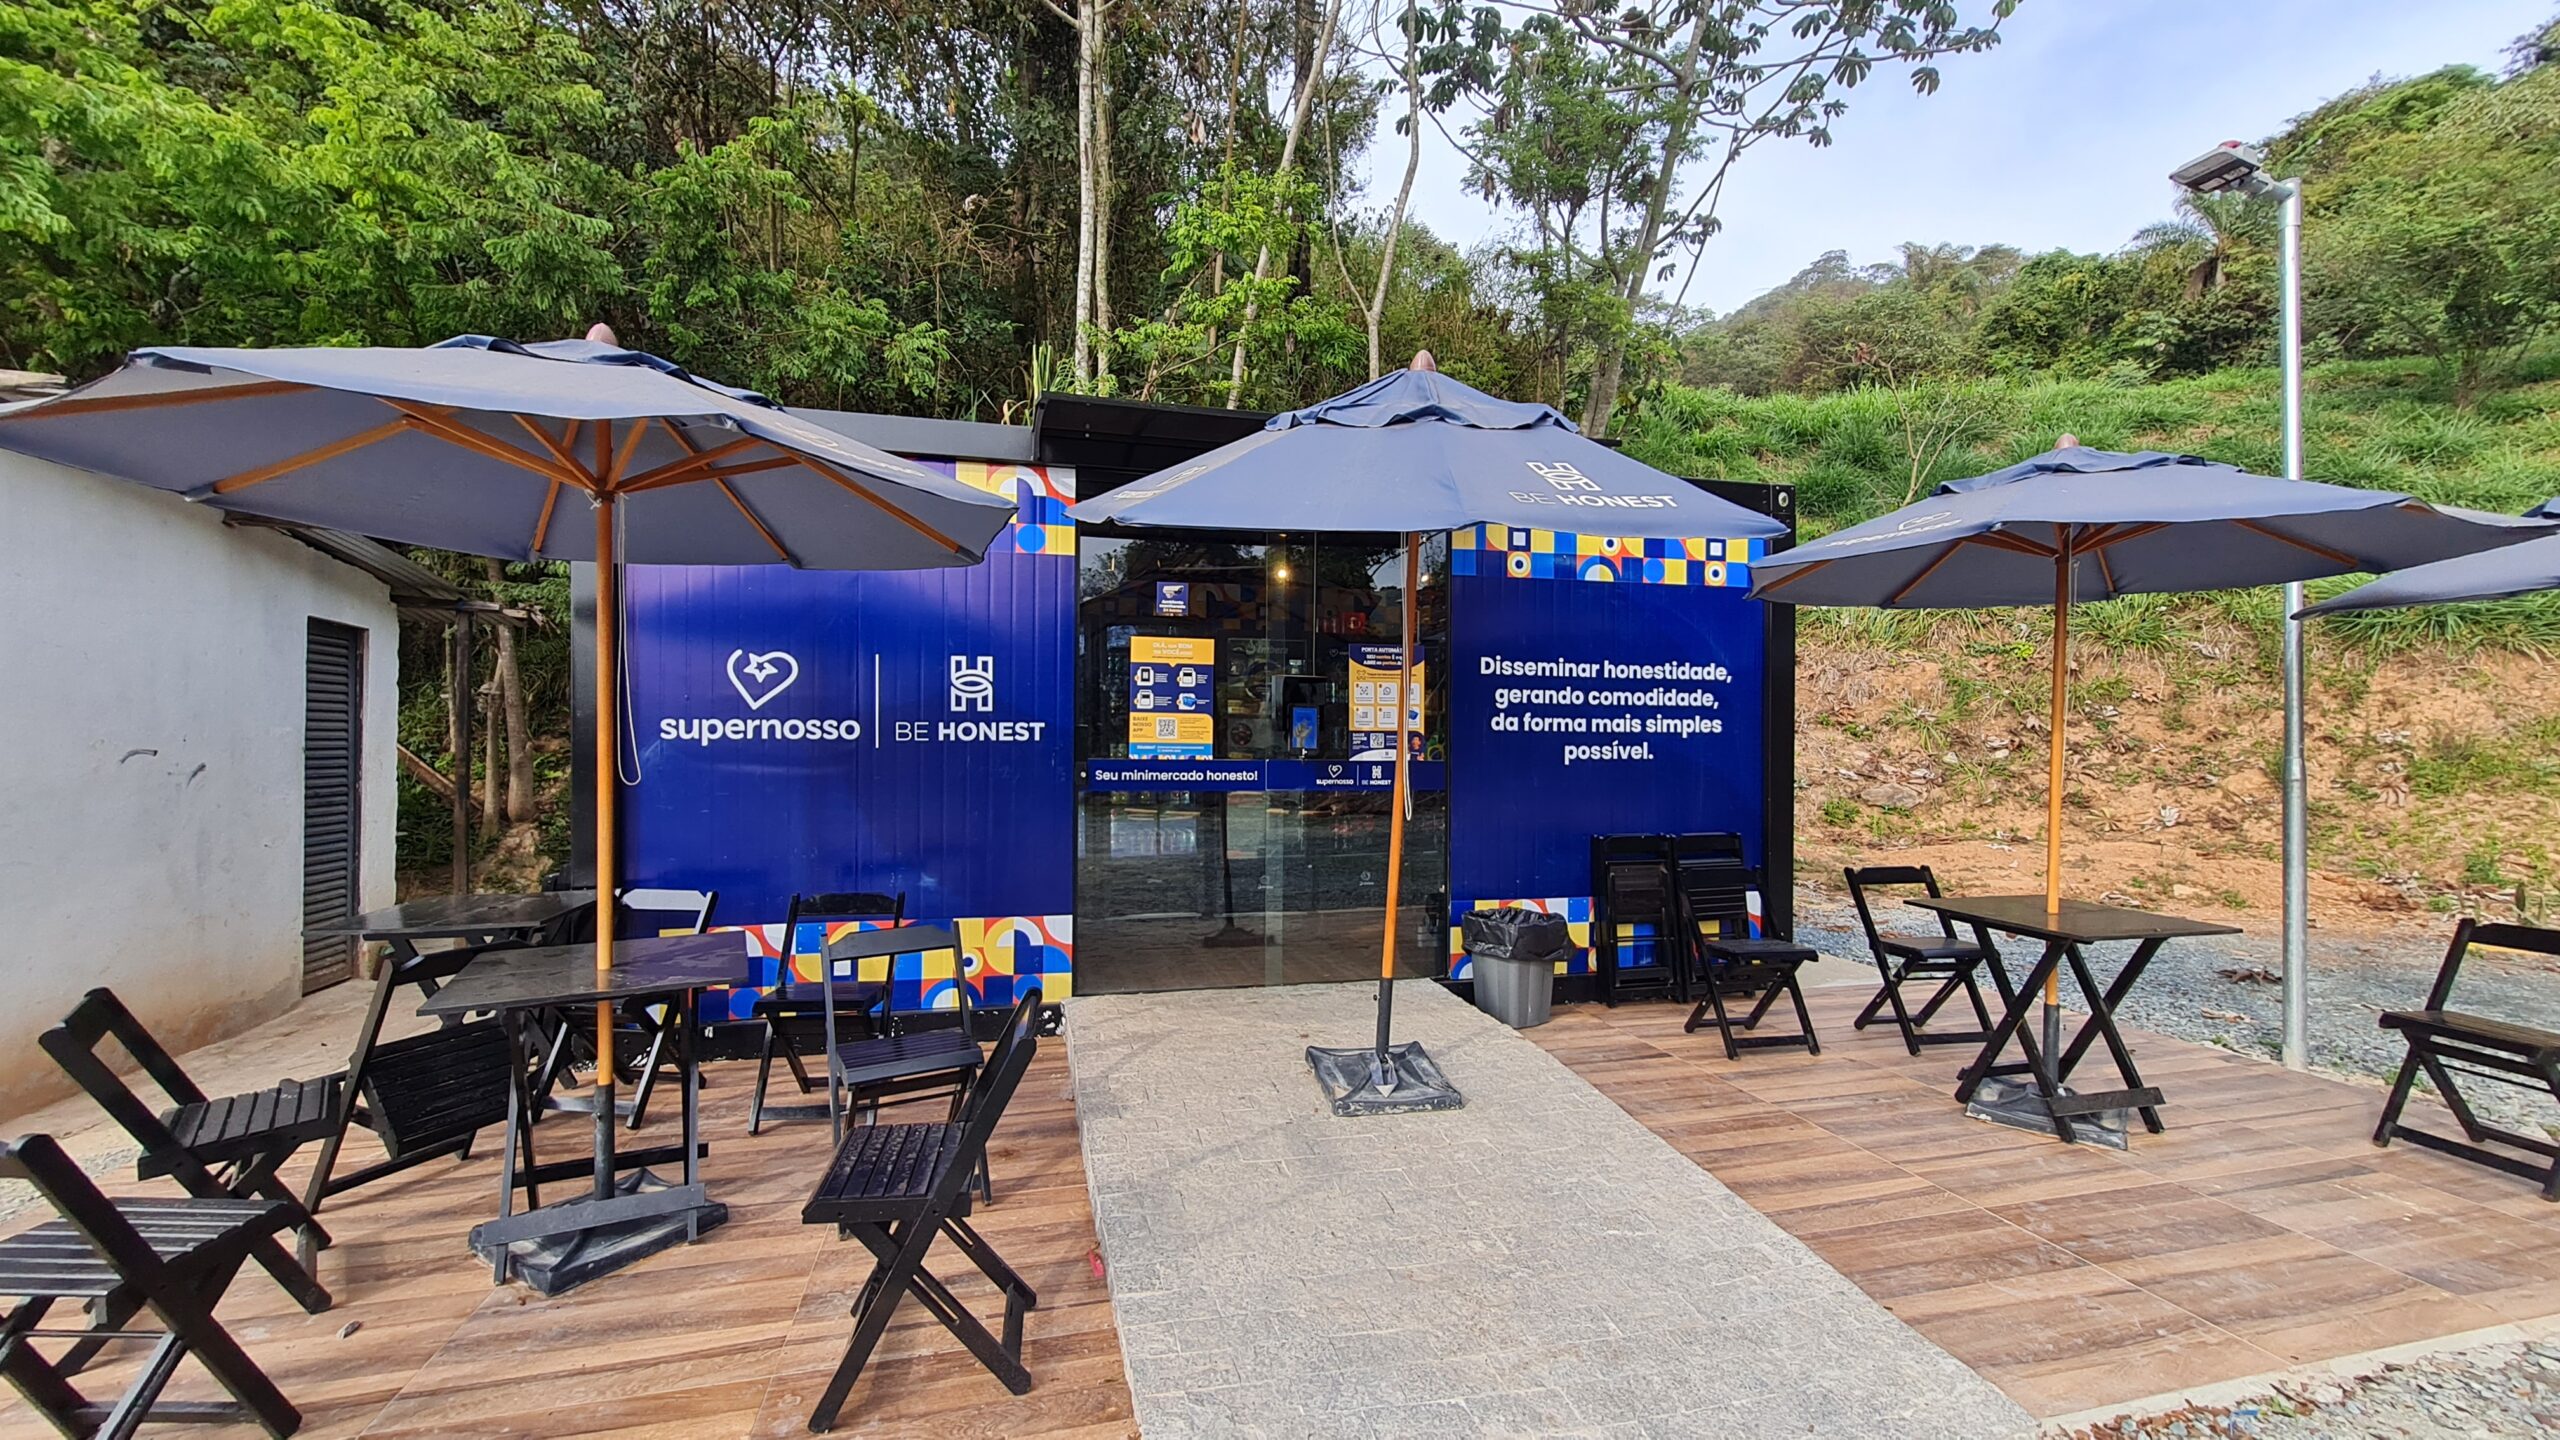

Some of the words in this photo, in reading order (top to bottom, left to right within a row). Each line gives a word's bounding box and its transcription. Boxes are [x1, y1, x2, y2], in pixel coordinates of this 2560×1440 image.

[1508, 491, 1556, 505] BE
[1555, 494, 1678, 508] HONEST
[1480, 655, 1600, 679] Disseminar
[1603, 660, 1732, 683] honestidade,
[1495, 686, 1584, 709] gerando
[1588, 687, 1719, 709] comodidade,
[659, 717, 861, 747] supernosso
[895, 721, 930, 742] BE
[938, 721, 1046, 742] HONEST
[1490, 713, 1519, 731] da
[1523, 712, 1587, 732] forma
[1591, 714, 1642, 733] mais
[1645, 714, 1722, 738] simples
[1564, 740, 1654, 765] possível.
[1095, 770, 1118, 781] Seu
[1121, 769, 1204, 781] minimercado
[1206, 770, 1258, 781] honesto!
[1316, 778, 1354, 786] supernosso
